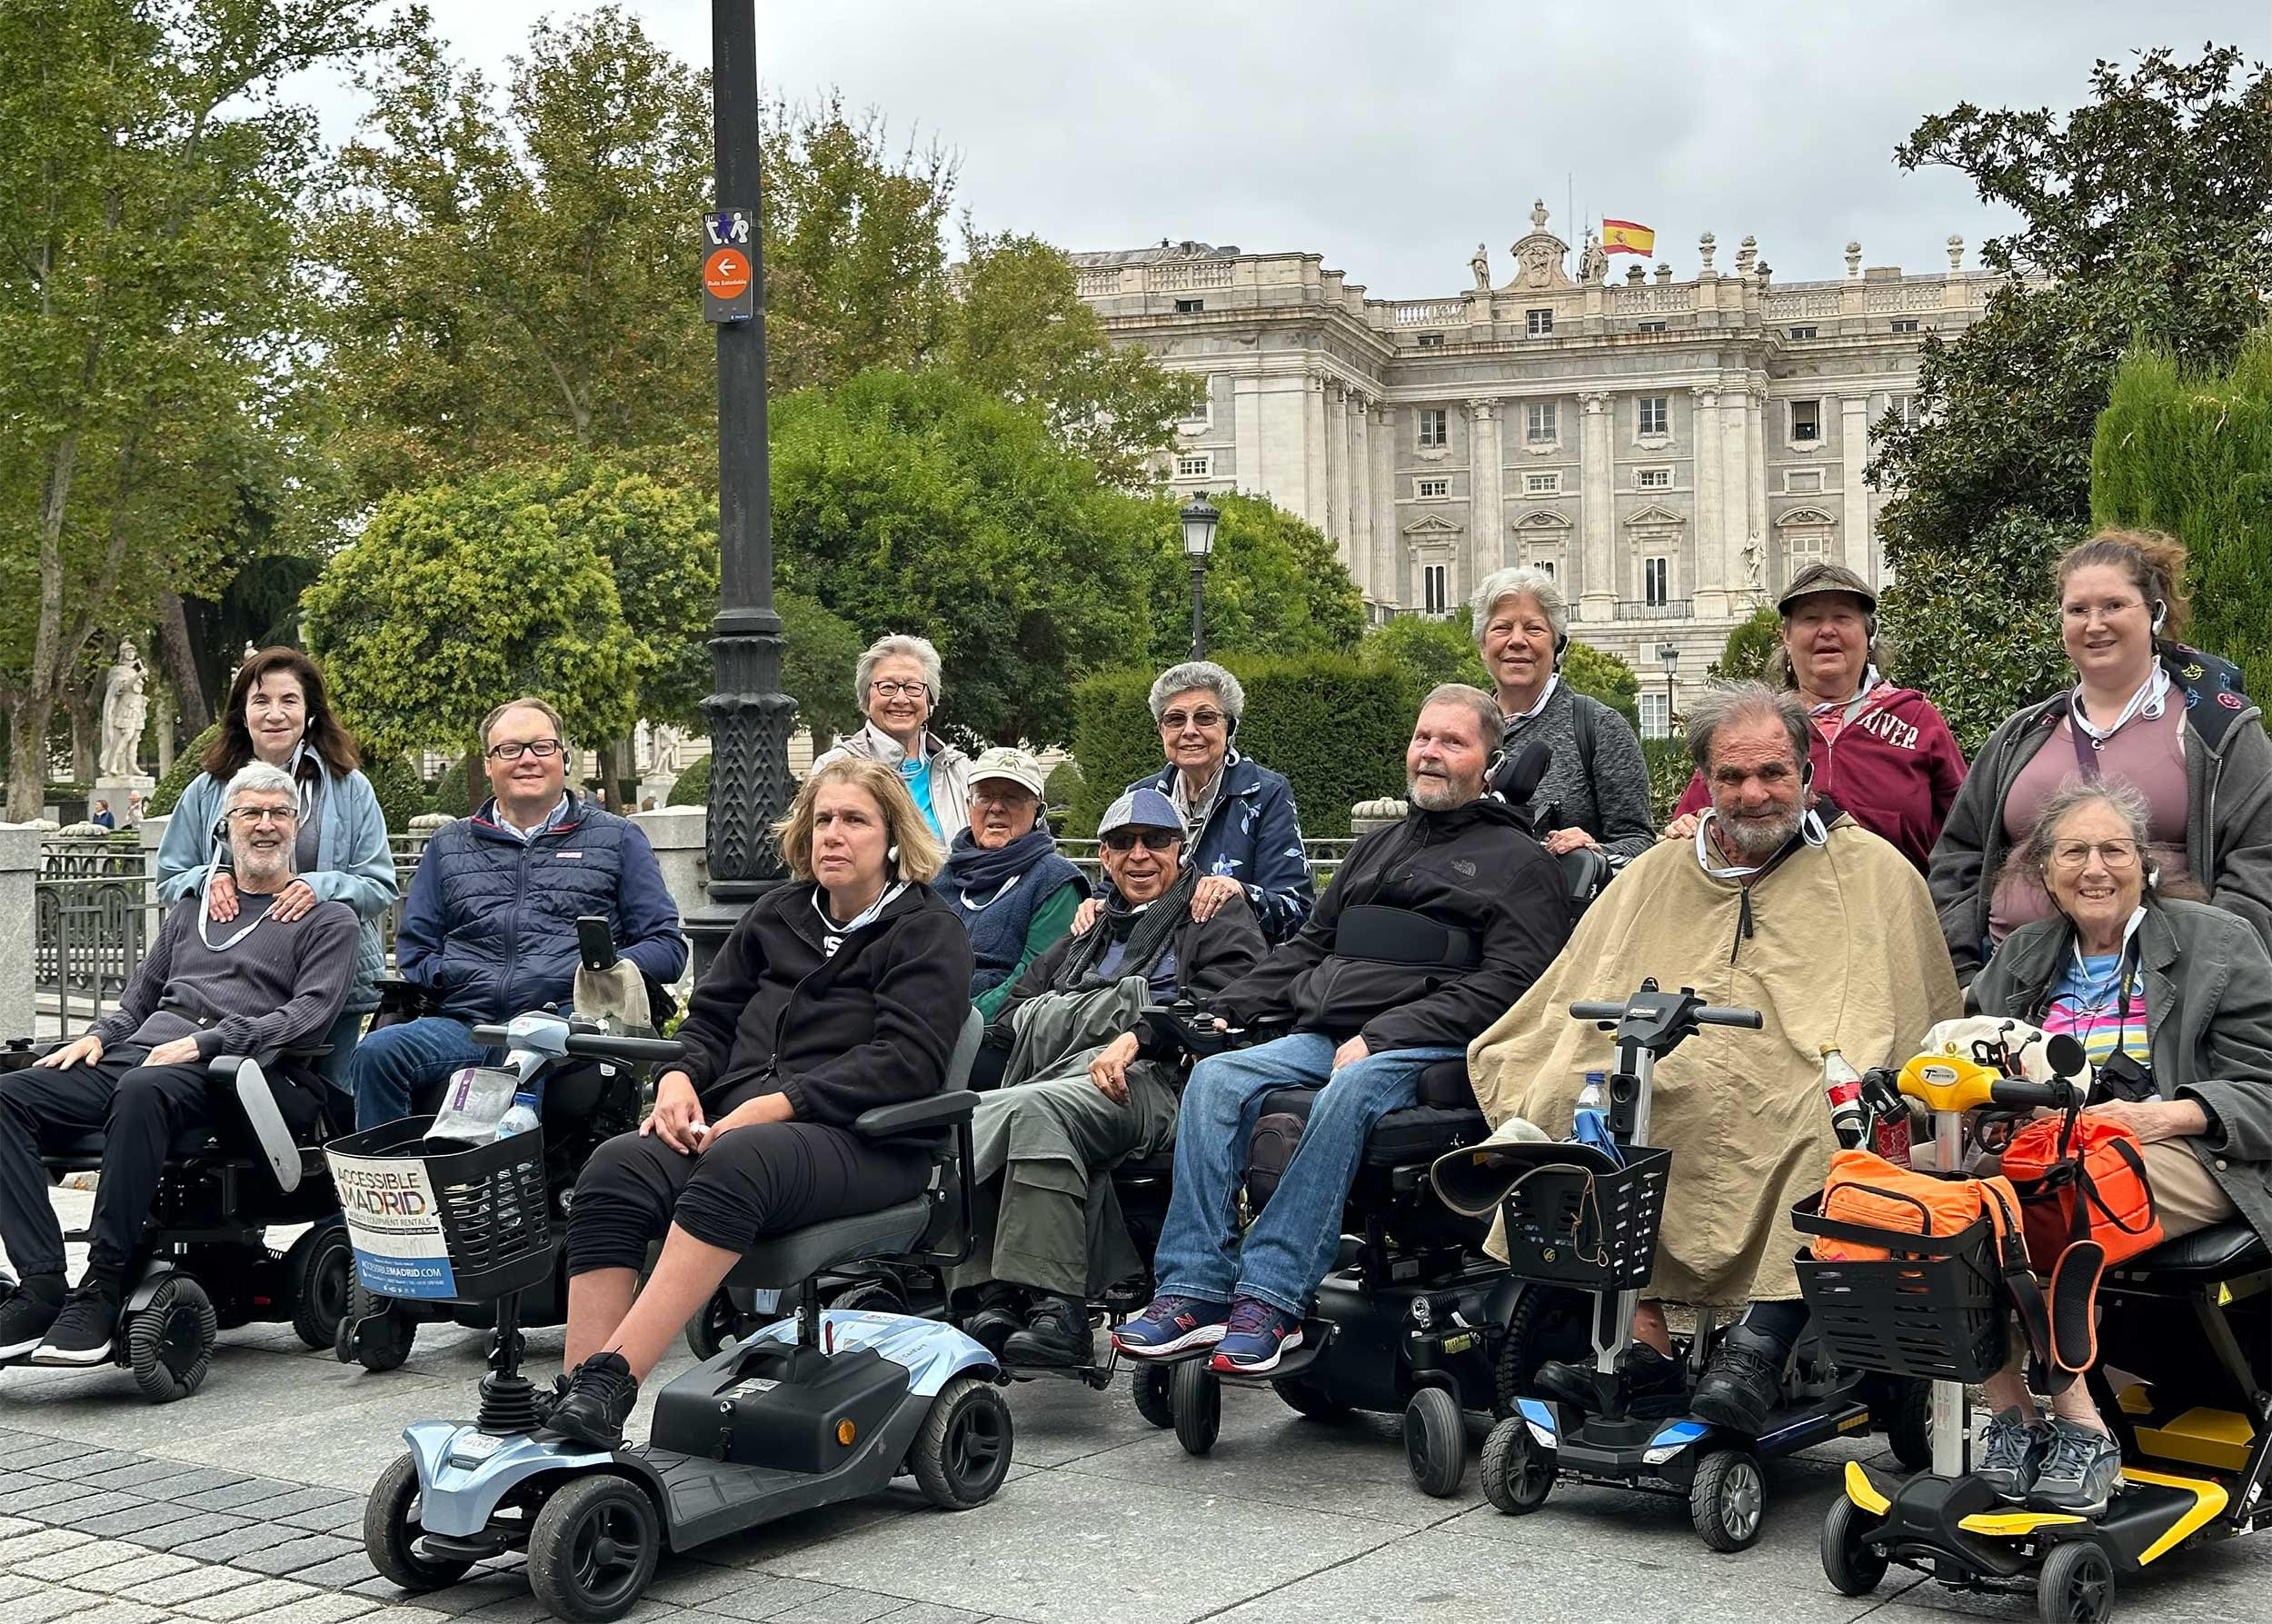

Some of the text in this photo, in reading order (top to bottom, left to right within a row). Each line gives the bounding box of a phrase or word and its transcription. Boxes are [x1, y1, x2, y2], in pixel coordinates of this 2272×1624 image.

[337, 1167, 421, 1190] ACCESSIBLE
[341, 1184, 426, 1215] MADRID
[366, 1216, 401, 1226] EQUIPMENT
[400, 1218, 432, 1226] RENTALS
[362, 1260, 442, 1278] ACCESSIBLEMADRID.COM
